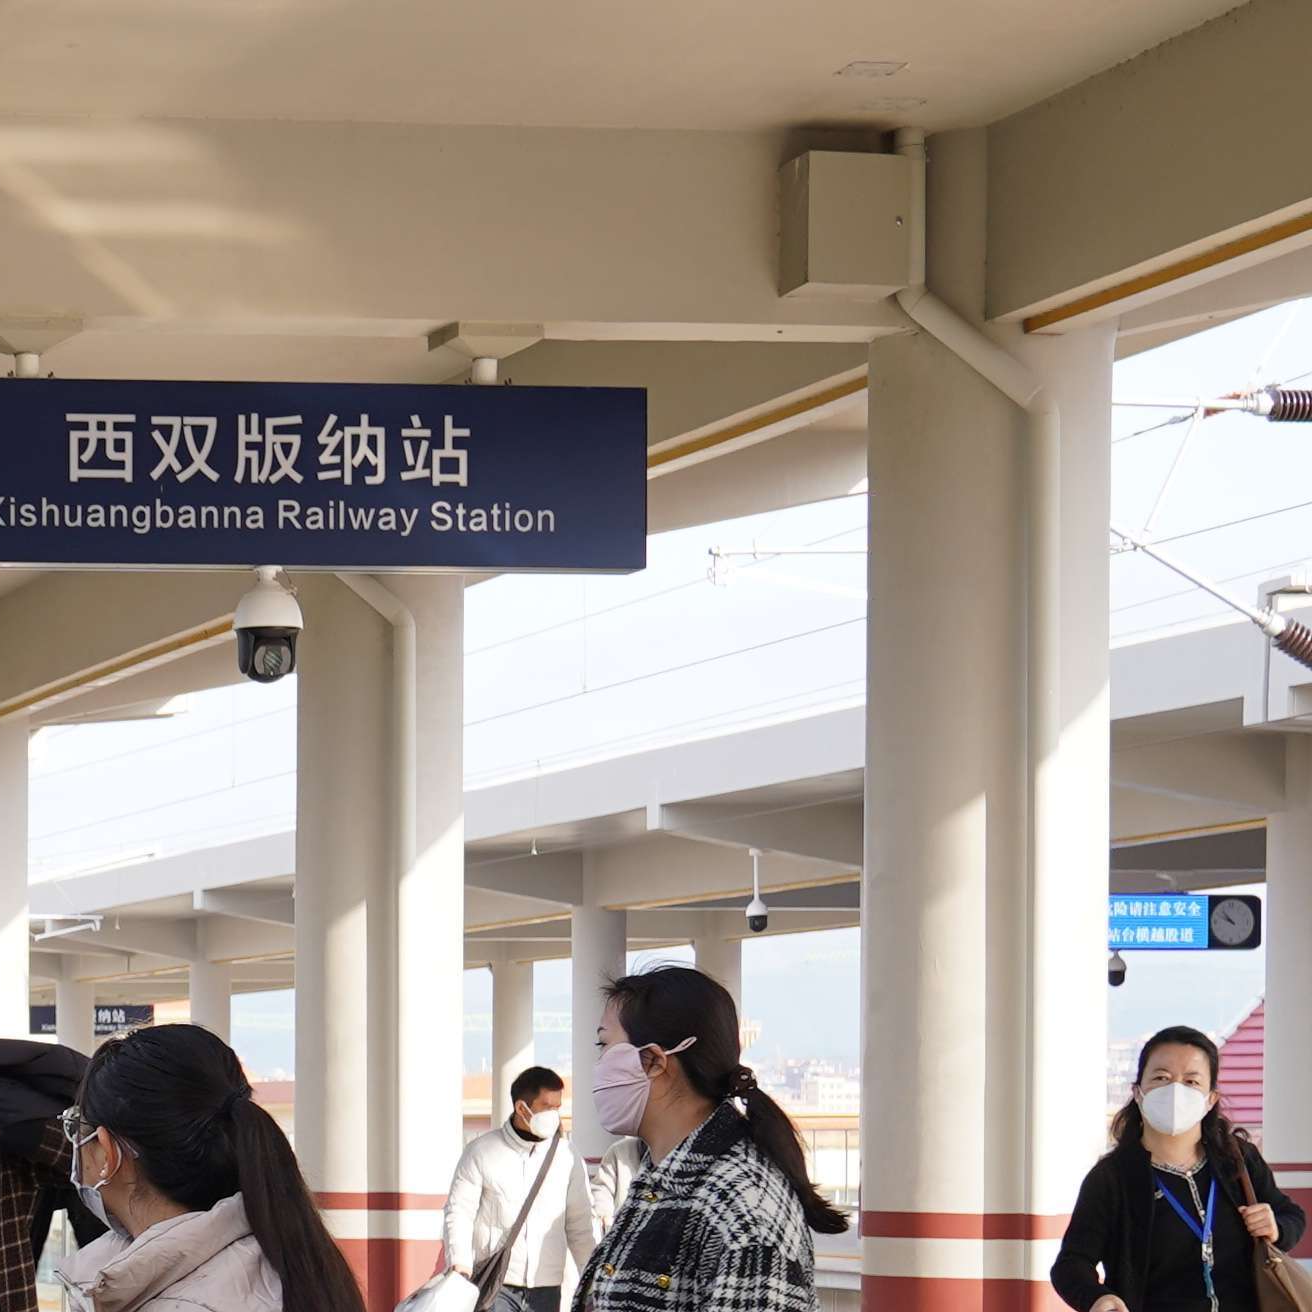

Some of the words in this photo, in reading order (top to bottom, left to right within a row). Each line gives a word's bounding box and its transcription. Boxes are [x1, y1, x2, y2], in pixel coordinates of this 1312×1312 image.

[64, 412, 472, 487] 西双版纳站
[278, 499, 420, 537] Railway
[430, 501, 556, 533] Station
